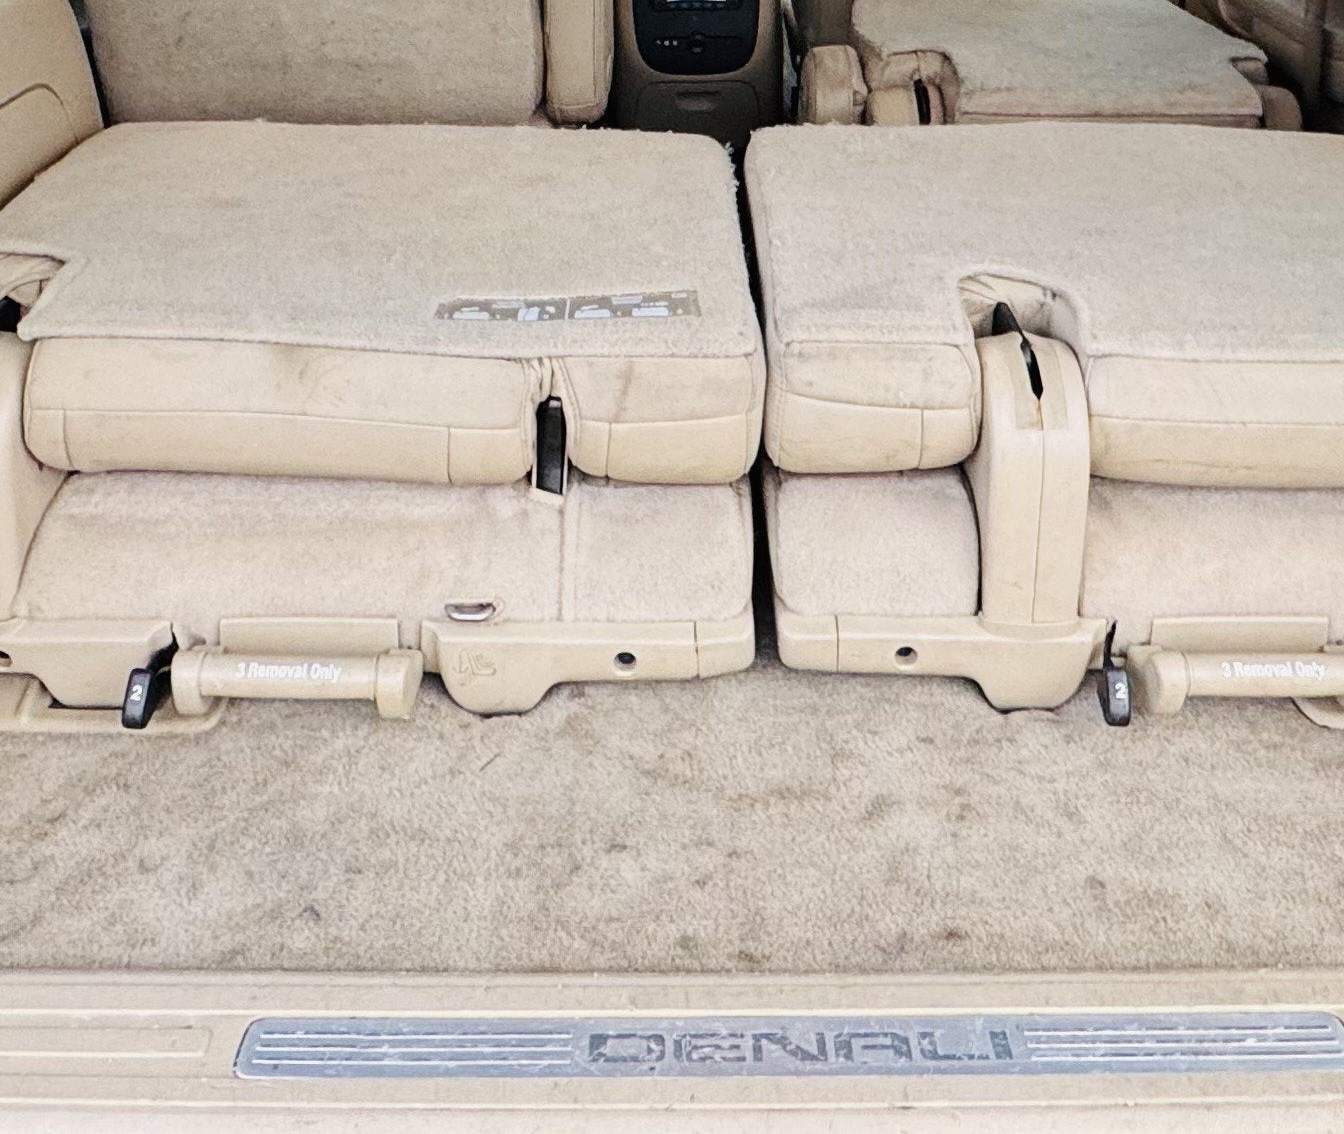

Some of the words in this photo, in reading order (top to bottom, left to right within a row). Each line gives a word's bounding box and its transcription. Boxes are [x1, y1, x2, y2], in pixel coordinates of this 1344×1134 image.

[236, 662, 246, 678] 3
[247, 661, 308, 679] Removal
[309, 663, 342, 683] Only
[1233, 661, 1294, 678] Removal
[1295, 661, 1325, 681] Only
[129, 684, 143, 701] 2
[1114, 682, 1127, 699] 2
[588, 1030, 1014, 1064] DENALI
